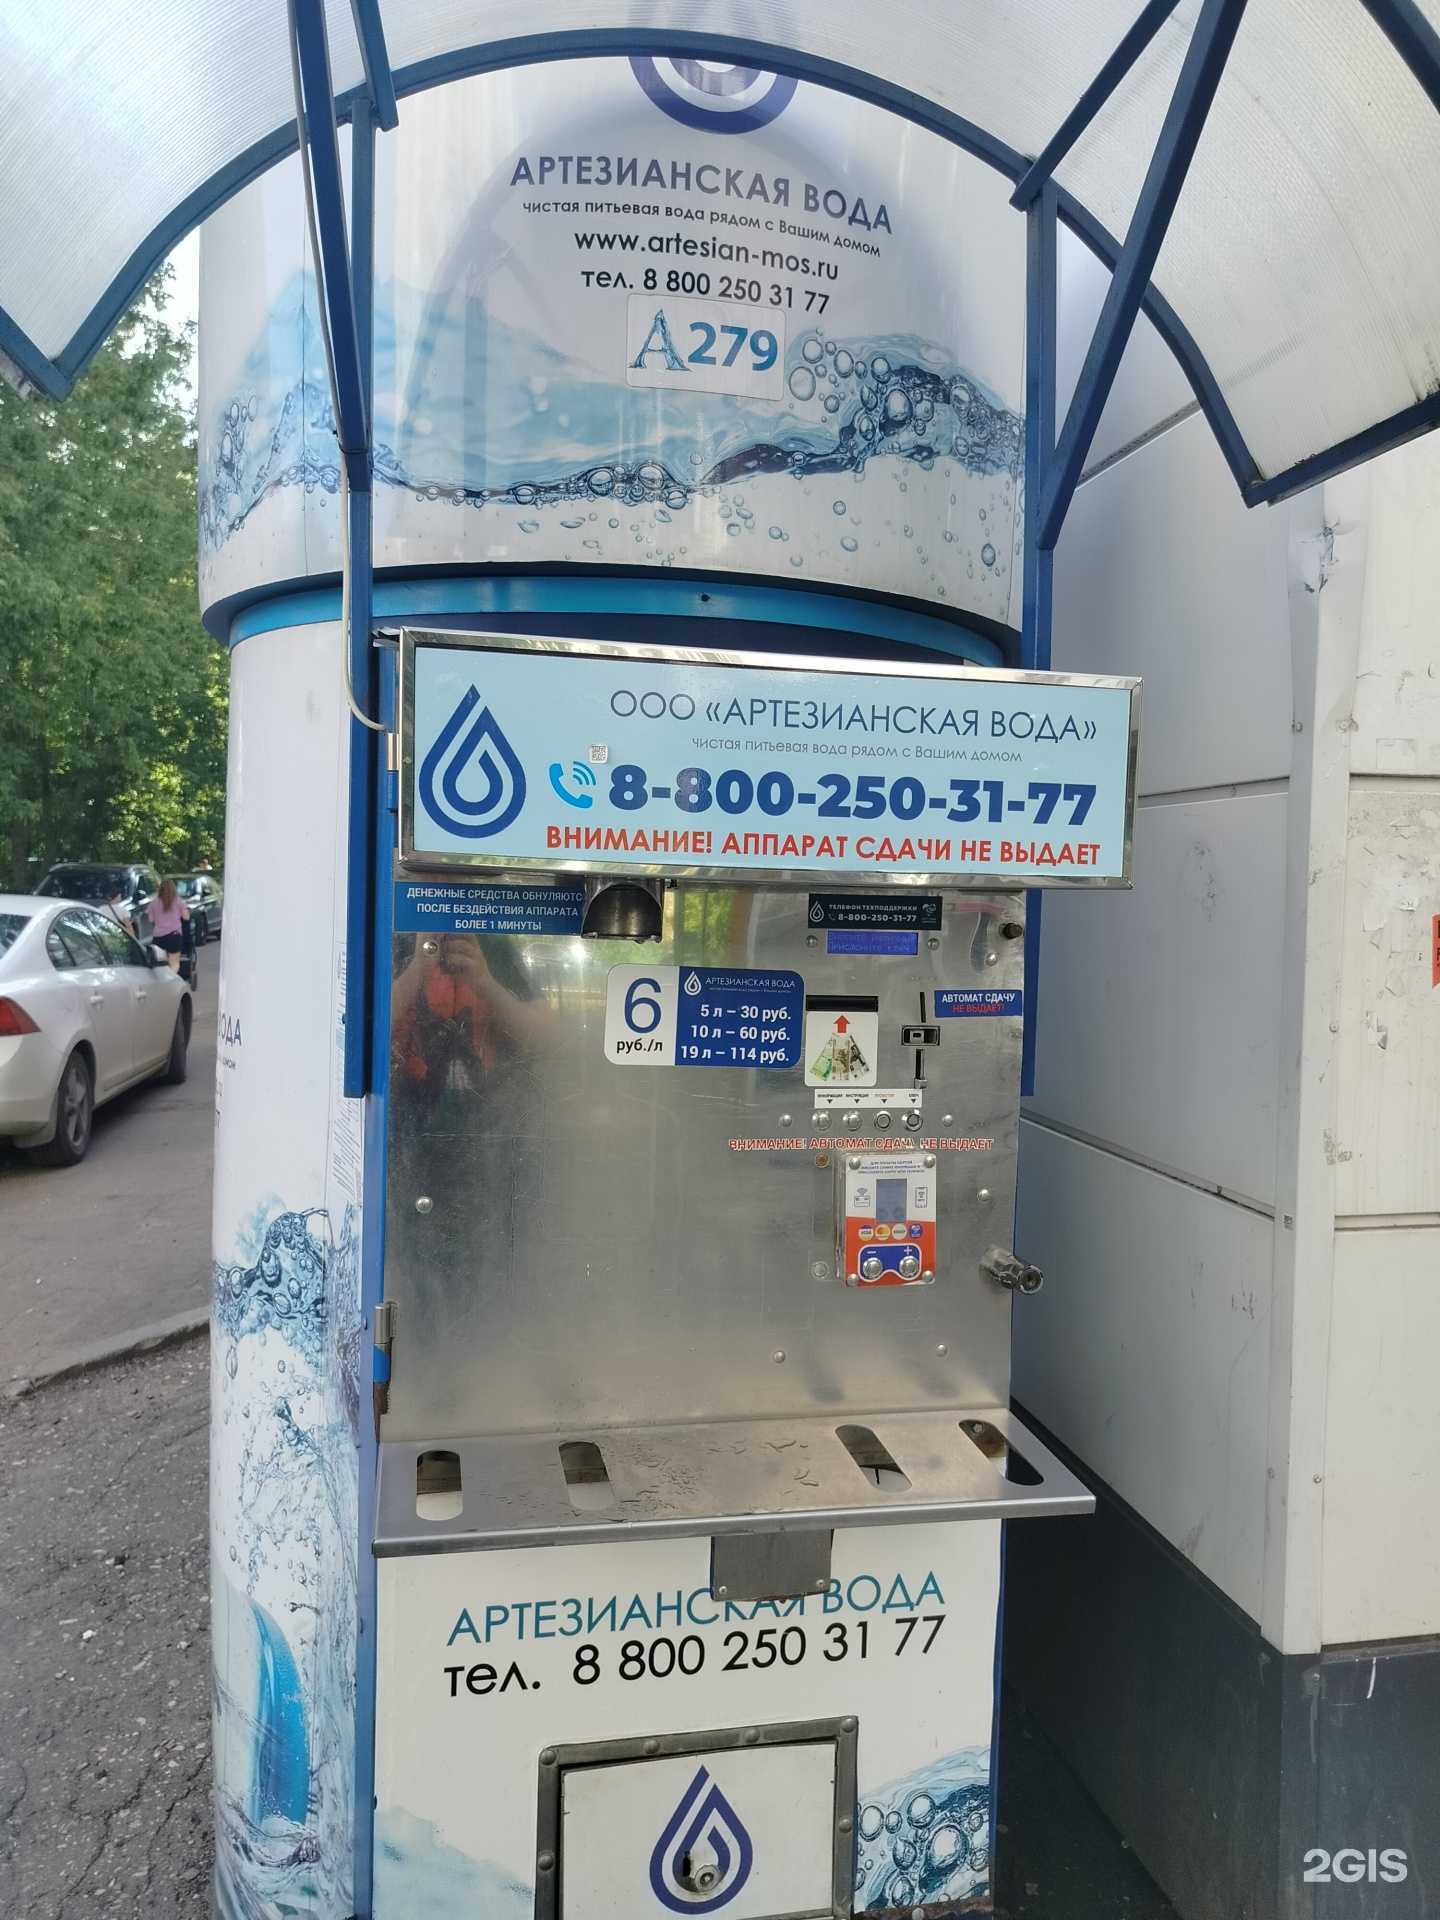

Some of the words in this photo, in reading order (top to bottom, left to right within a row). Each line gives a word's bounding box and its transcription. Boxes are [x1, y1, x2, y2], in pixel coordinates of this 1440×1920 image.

[510, 155, 790, 208] АРТЕЗИАНСКАЯ
[804, 183, 893, 234] ВОДА
[522, 201, 580, 214] чистая
[585, 202, 660, 216] питьевая
[665, 207, 705, 221] вода
[709, 210, 761, 231] рядом
[765, 220, 774, 231] с
[779, 220, 830, 243] Вашим
[834, 237, 881, 257] домом
[574, 231, 839, 280] www.artesian-mos.ru
[581, 269, 634, 289] тел.
[642, 268, 658, 290] 8
[666, 270, 711, 295] 800
[718, 276, 762, 303] 250
[768, 284, 794, 308] 31
[803, 291, 830, 315] 77
[610, 690, 696, 720] ООО
[705, 697, 979, 737] «АРТЕЗИАНСКАЯ
[991, 710, 1097, 743] ВОДА»
[692, 737, 741, 751] чистая
[745, 740, 808, 754] питьевая
[812, 743, 847, 756] вода
[851, 745, 897, 759] рядом
[902, 748, 911, 758] с
[915, 746, 967, 760] Вашим
[970, 751, 1022, 763] домом
[609, 764, 1097, 826] 8-800-250-31-77
[547, 825, 712, 854] ВНИМАНИЕ!
[721, 832, 848, 857] АППАРАТ
[855, 836, 951, 862] СДАЧИ
[961, 840, 992, 862] НЕ
[1000, 841, 1100, 867] ВЫДАЕТ
[407, 887, 465, 899] ДЕНЕЖНЫЕ
[467, 889, 520, 901] СРЕДСТВА
[522, 891, 583, 902] ОБНУЛЯЮТС
[417, 903, 451, 913] ПОСЛЕ
[453, 902, 524, 916] БЕЗДЕЙСТВИЯ
[526, 905, 578, 916] АППАРАТА
[838, 913, 917, 922] 8-800-250-31-77
[455, 919, 487, 929] БОЛЕЕ
[490, 920, 495, 929] 1
[497, 920, 542, 930] МИНУТЫ
[705, 976, 770, 986] АРТЕЗИАНСКАЯ
[771, 979, 796, 988] ВОДА
[624, 977, 662, 1034] 6
[942, 993, 983, 1003] АВТОМАТ
[985, 993, 1015, 1004] СДАЧУ
[700, 1005, 709, 1017] 5
[712, 1008, 722, 1018] л
[740, 1006, 759, 1019] 30
[762, 1006, 791, 1022] руб.
[691, 1025, 708, 1038] 10
[712, 1028, 722, 1039] л
[739, 1026, 757, 1040] 60
[761, 1027, 790, 1043] руб.
[616, 1037, 663, 1054] руб./л
[681, 1045, 698, 1059] 19
[701, 1048, 711, 1059] л
[730, 1047, 756, 1060] 114
[760, 1048, 789, 1064] руб.
[810, 1138, 871, 1150] АВТОМАТ
[920, 1138, 938, 1150] НЕ
[940, 1138, 994, 1151] ВЫДАЕТ
[822, 1571, 945, 1614] ВОДА
[444, 1661, 540, 1696] тел.
[573, 1644, 600, 1684] 8
[619, 1635, 705, 1681] 800
[722, 1626, 806, 1671] 250
[823, 1620, 869, 1661] 31
[895, 1614, 946, 1656] 77
